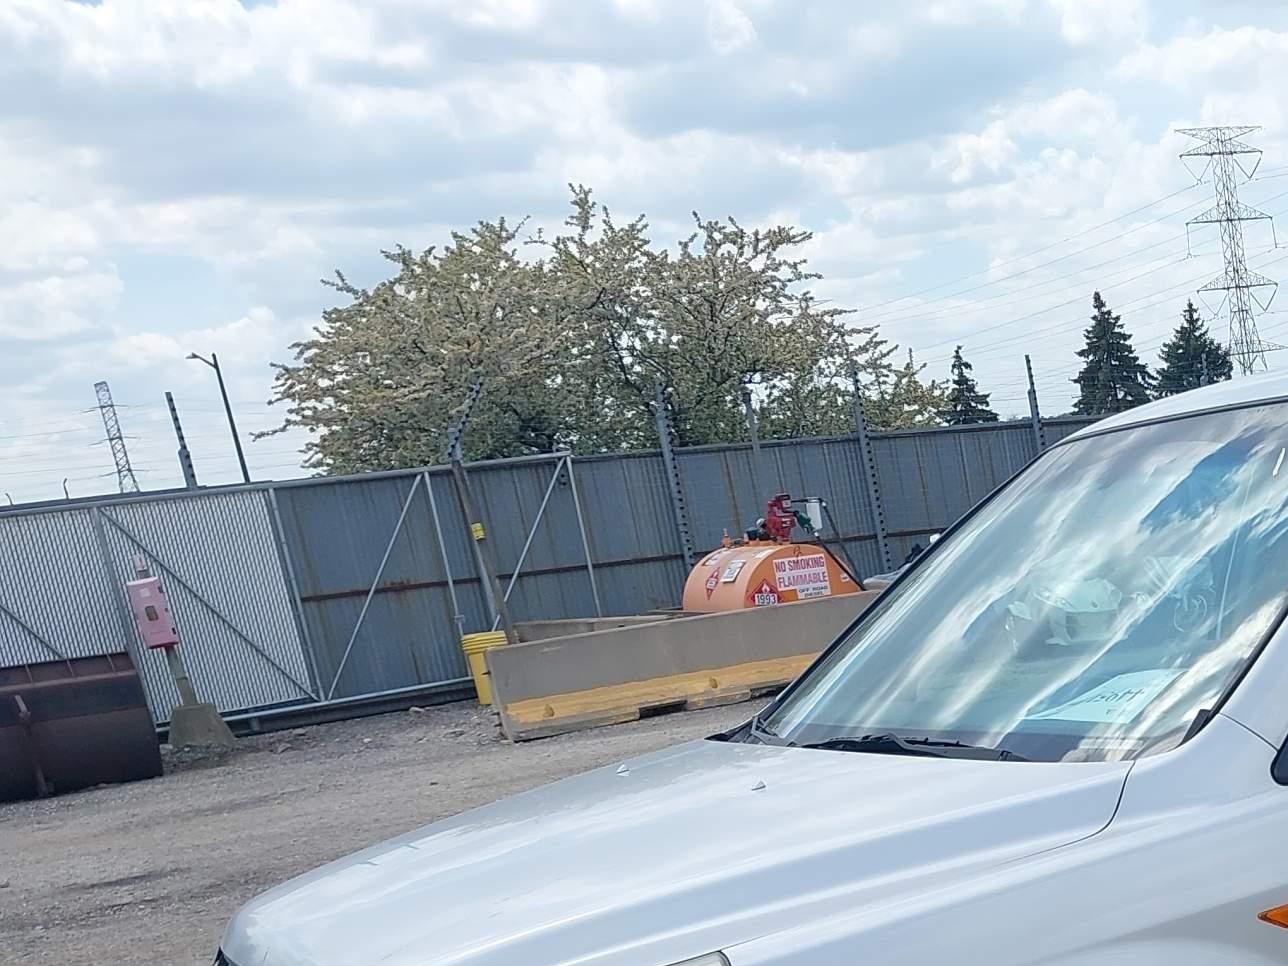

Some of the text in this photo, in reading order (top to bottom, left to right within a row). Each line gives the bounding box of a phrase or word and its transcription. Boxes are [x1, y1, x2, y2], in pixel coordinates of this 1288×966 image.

[774, 555, 825, 573] NO SMOKING
[778, 572, 828, 588] FLAMMABLE
[756, 594, 777, 605] 1993
